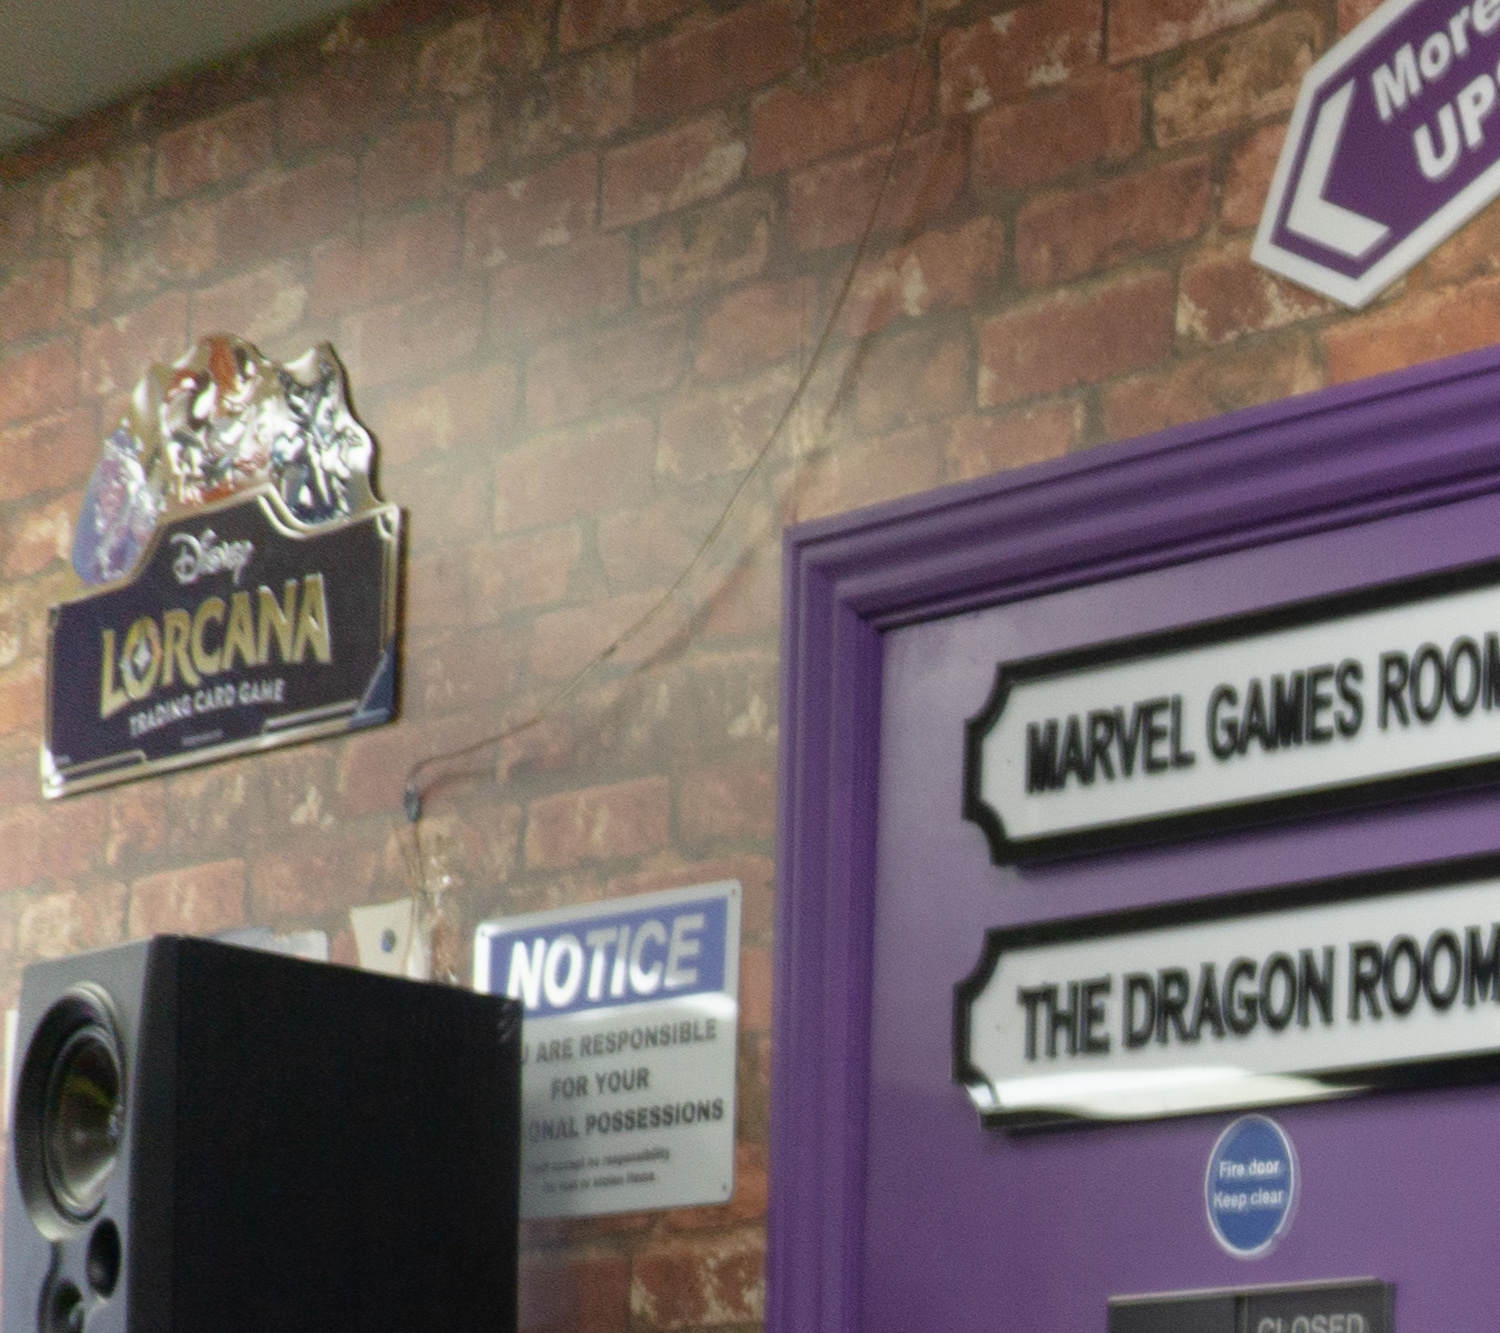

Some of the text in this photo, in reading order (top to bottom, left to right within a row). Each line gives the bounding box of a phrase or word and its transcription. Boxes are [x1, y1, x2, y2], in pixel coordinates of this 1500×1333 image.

[99, 570, 333, 722] LORCANA
[129, 693, 192, 738] TRADING
[194, 684, 237, 713] CARD
[238, 678, 286, 703] GAME
[1024, 692, 1194, 796] MARVEL
[1206, 662, 1365, 761] GAMES
[506, 912, 706, 1011] NOTICE
[1018, 973, 1111, 1062] THE
[1122, 945, 1335, 1051] DRAGON
[535, 1018, 719, 1065] ARE RESPONSIBLE
[551, 1066, 650, 1101] FOR YOUR
[584, 1097, 725, 1137] POSSESSIONS
[1218, 1156, 1281, 1181] Fire door
[1213, 1184, 1286, 1212] Keep clear
